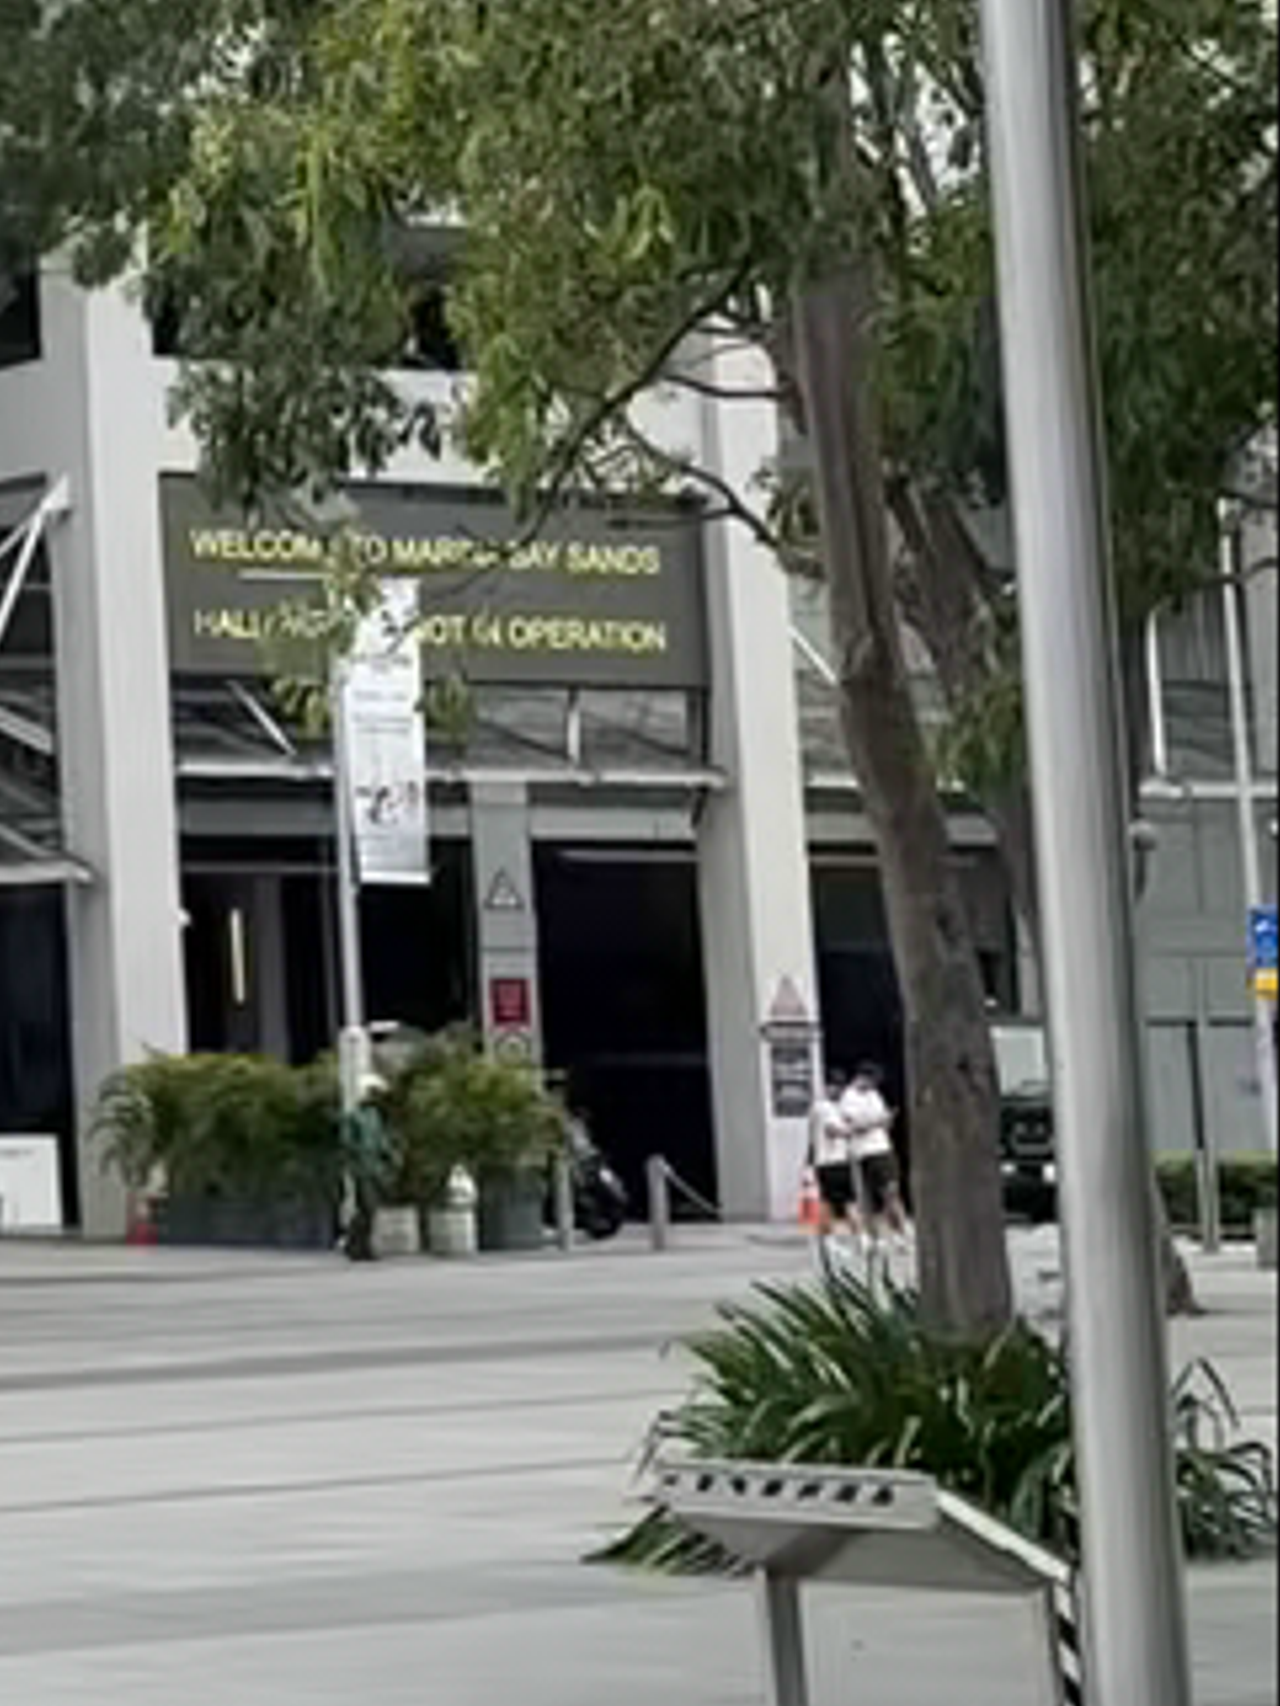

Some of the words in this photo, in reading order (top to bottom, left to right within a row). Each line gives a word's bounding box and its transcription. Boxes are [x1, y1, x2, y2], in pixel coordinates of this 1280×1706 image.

[191, 530, 343, 560] WELCOM
[567, 543, 661, 575] SANDS
[509, 618, 667, 651] OPERATION
